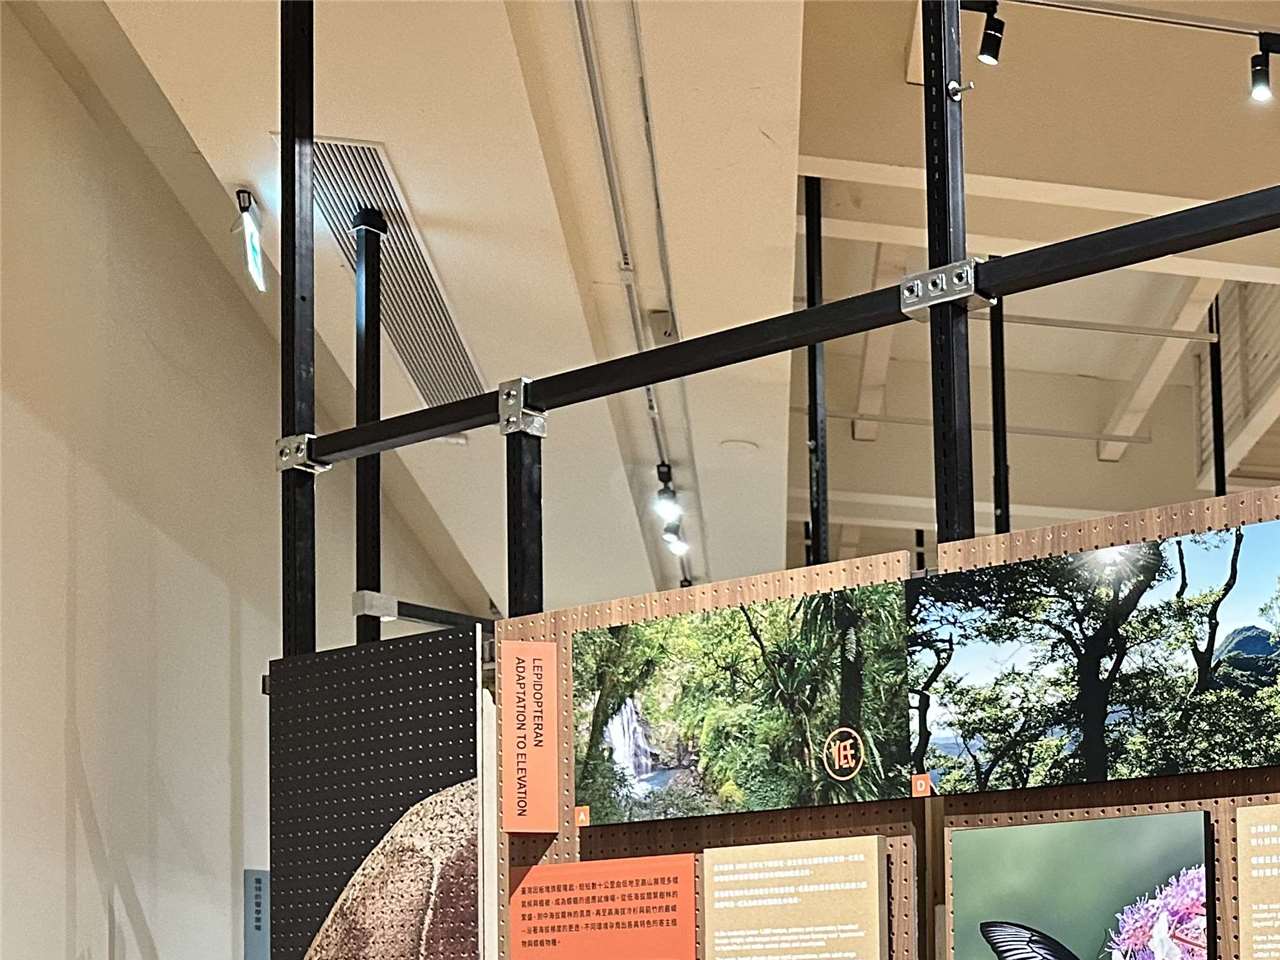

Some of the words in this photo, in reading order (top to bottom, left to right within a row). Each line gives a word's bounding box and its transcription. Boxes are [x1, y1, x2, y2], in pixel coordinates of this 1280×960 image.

[515, 656, 527, 731] ADAPTATION
[532, 658, 544, 748] LEPIDOPTERAN
[516, 734, 527, 750] TO
[830, 739, 856, 770] 低
[516, 754, 528, 817] ELEVATION
[916, 780, 926, 792] D
